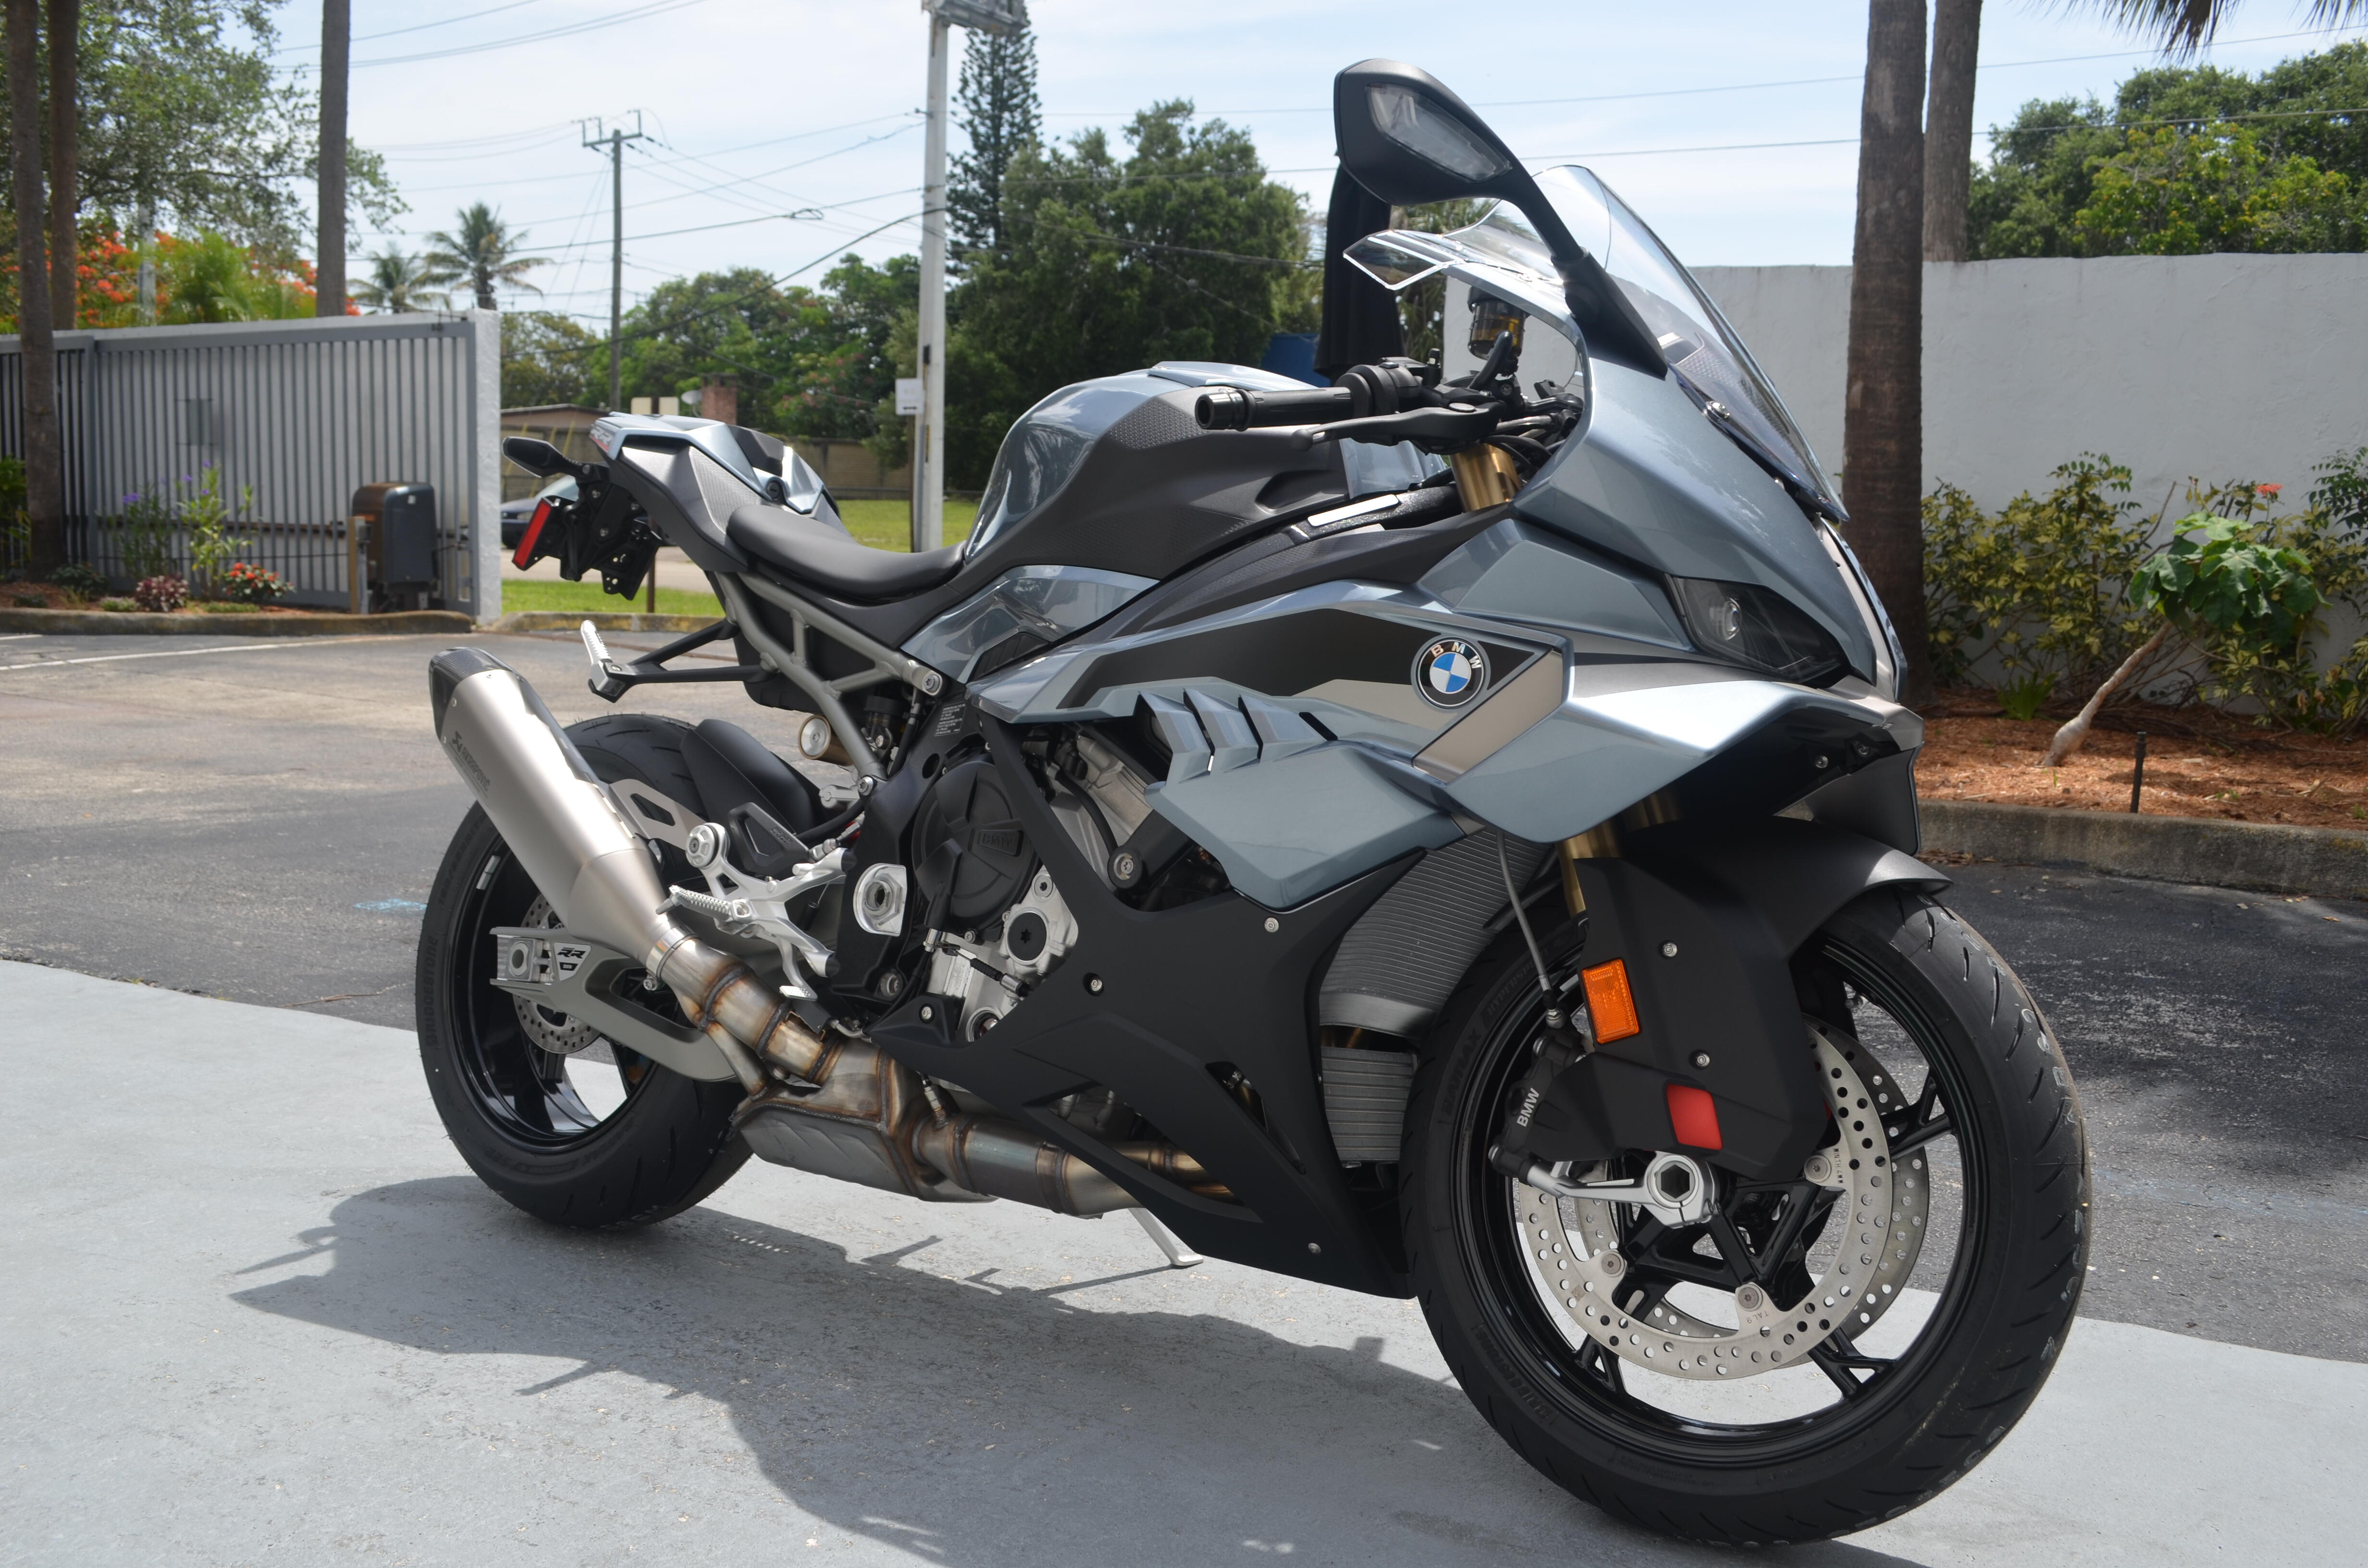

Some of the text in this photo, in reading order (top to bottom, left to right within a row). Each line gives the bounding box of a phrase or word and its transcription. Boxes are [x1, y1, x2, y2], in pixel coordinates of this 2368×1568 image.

[1430, 641, 1482, 669] BMW
[983, 833, 1012, 847] BMW
[422, 934, 439, 1047] BRIDGESTONE
[1516, 1087, 1540, 1127] BMW
